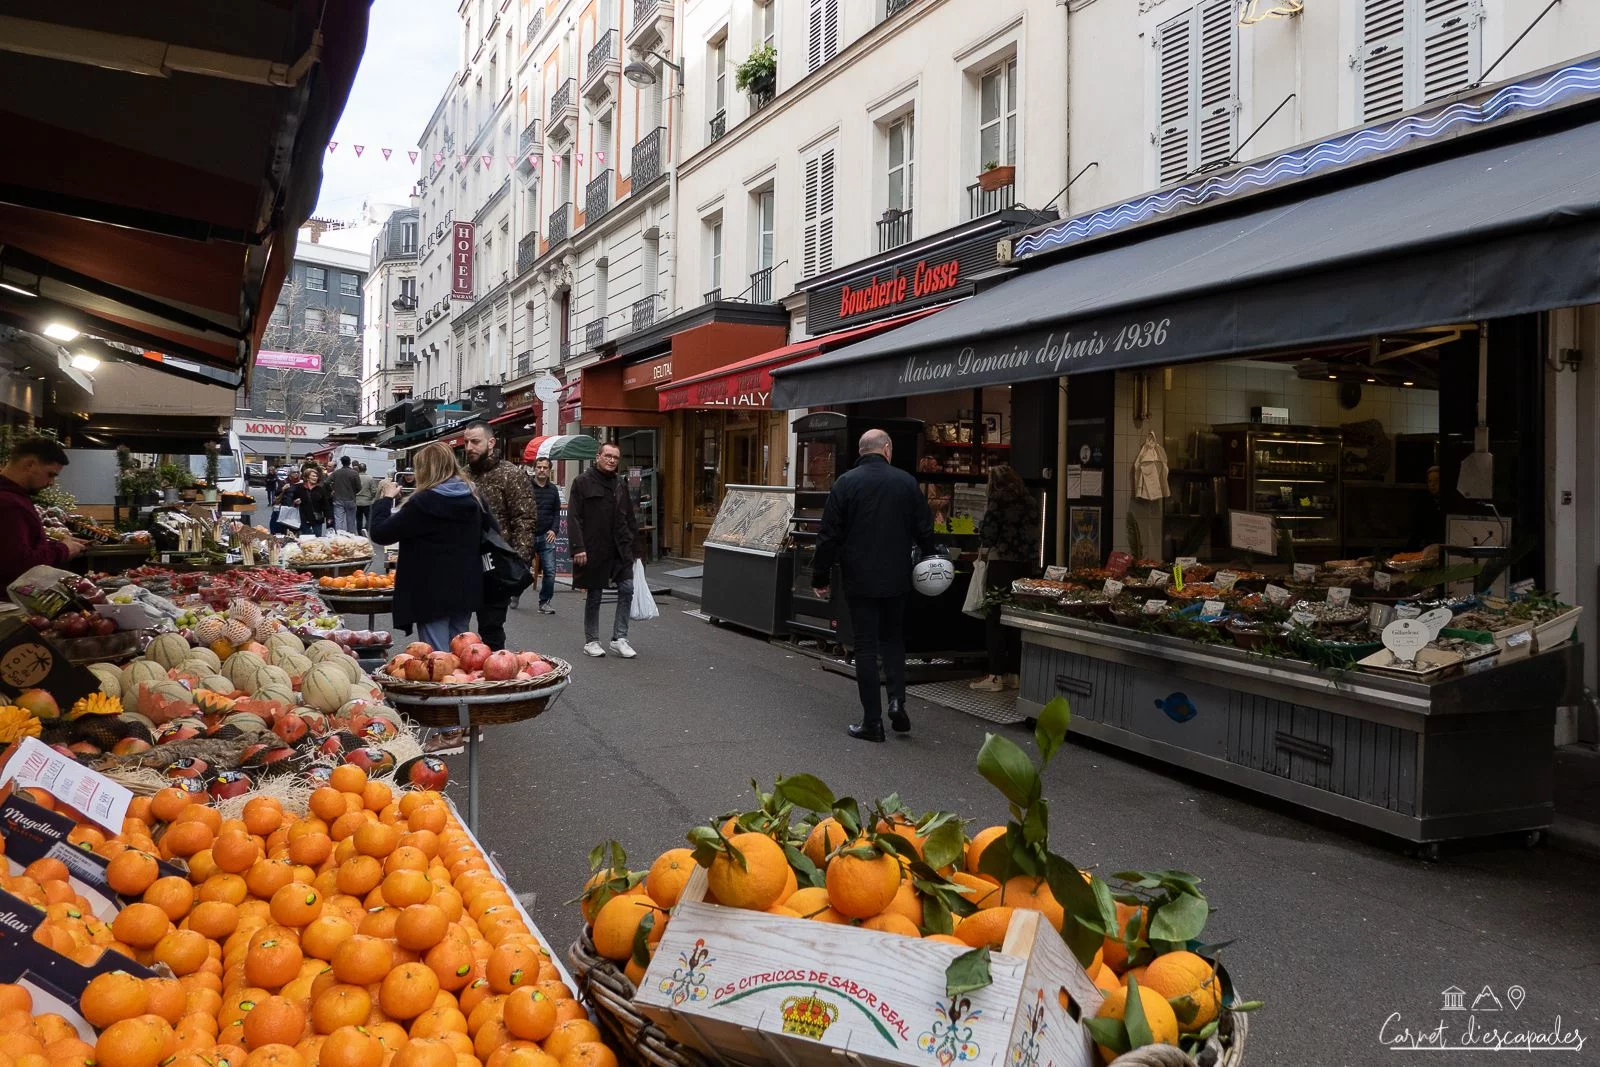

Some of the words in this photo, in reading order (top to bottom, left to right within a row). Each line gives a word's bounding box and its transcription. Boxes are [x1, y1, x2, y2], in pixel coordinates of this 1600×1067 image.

[457, 228, 470, 289] HOTEL
[839, 274, 907, 318] Boucherie
[914, 259, 959, 297] Cosse
[899, 355, 953, 384] Maison
[957, 346, 1032, 376] Domain
[1035, 330, 1110, 372] depuis
[1112, 318, 1171, 352] 1936
[245, 423, 308, 436] MONOPRIX
[4, 807, 62, 839] Magellan
[714, 983, 736, 999] OS
[739, 970, 805, 989] CITRICOS
[809, 970, 829, 982] DE
[828, 976, 878, 1008] SABOR
[878, 1002, 910, 1041] REAL
